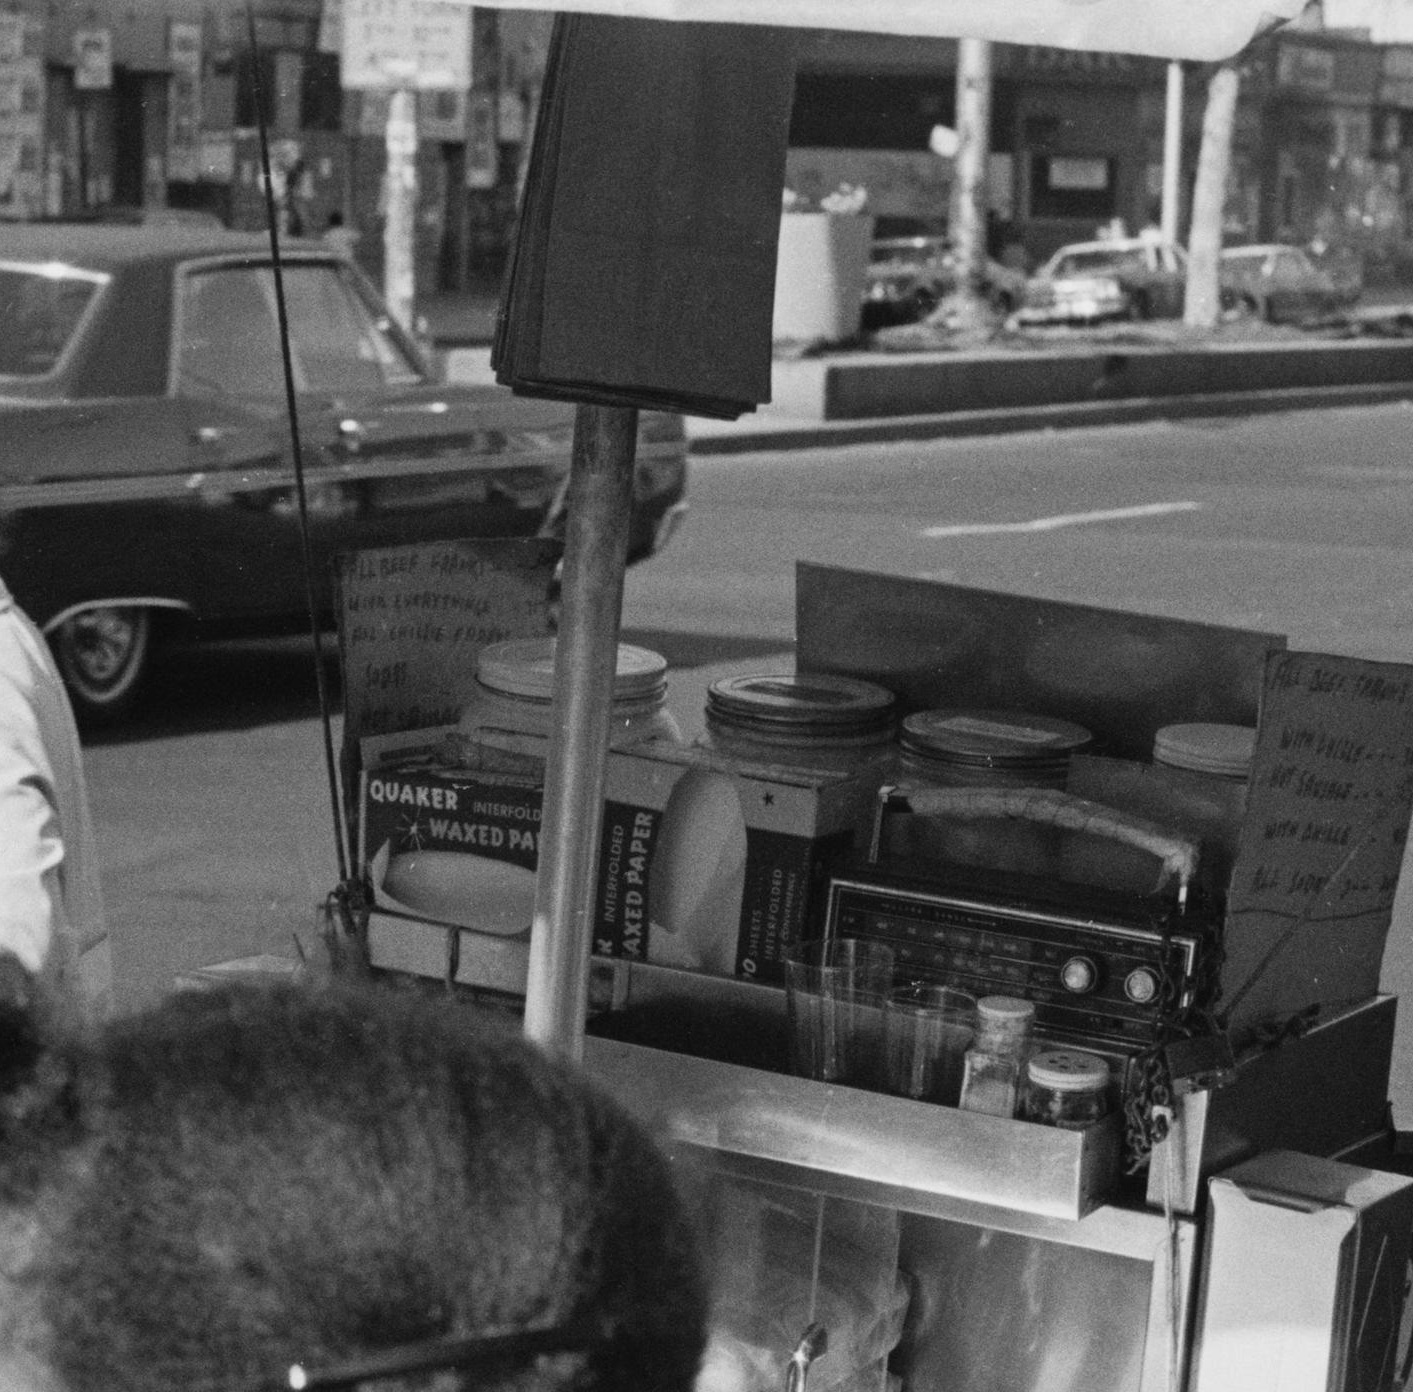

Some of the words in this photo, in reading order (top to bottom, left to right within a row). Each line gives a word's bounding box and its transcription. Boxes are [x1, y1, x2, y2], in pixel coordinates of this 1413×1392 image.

[370, 779, 458, 811] QUAKER
[429, 817, 504, 848] WAXED
[625, 811, 654, 885] PAPER
[603, 824, 625, 923] INTERFOLDED
[764, 868, 783, 961] INTERFOLDED
